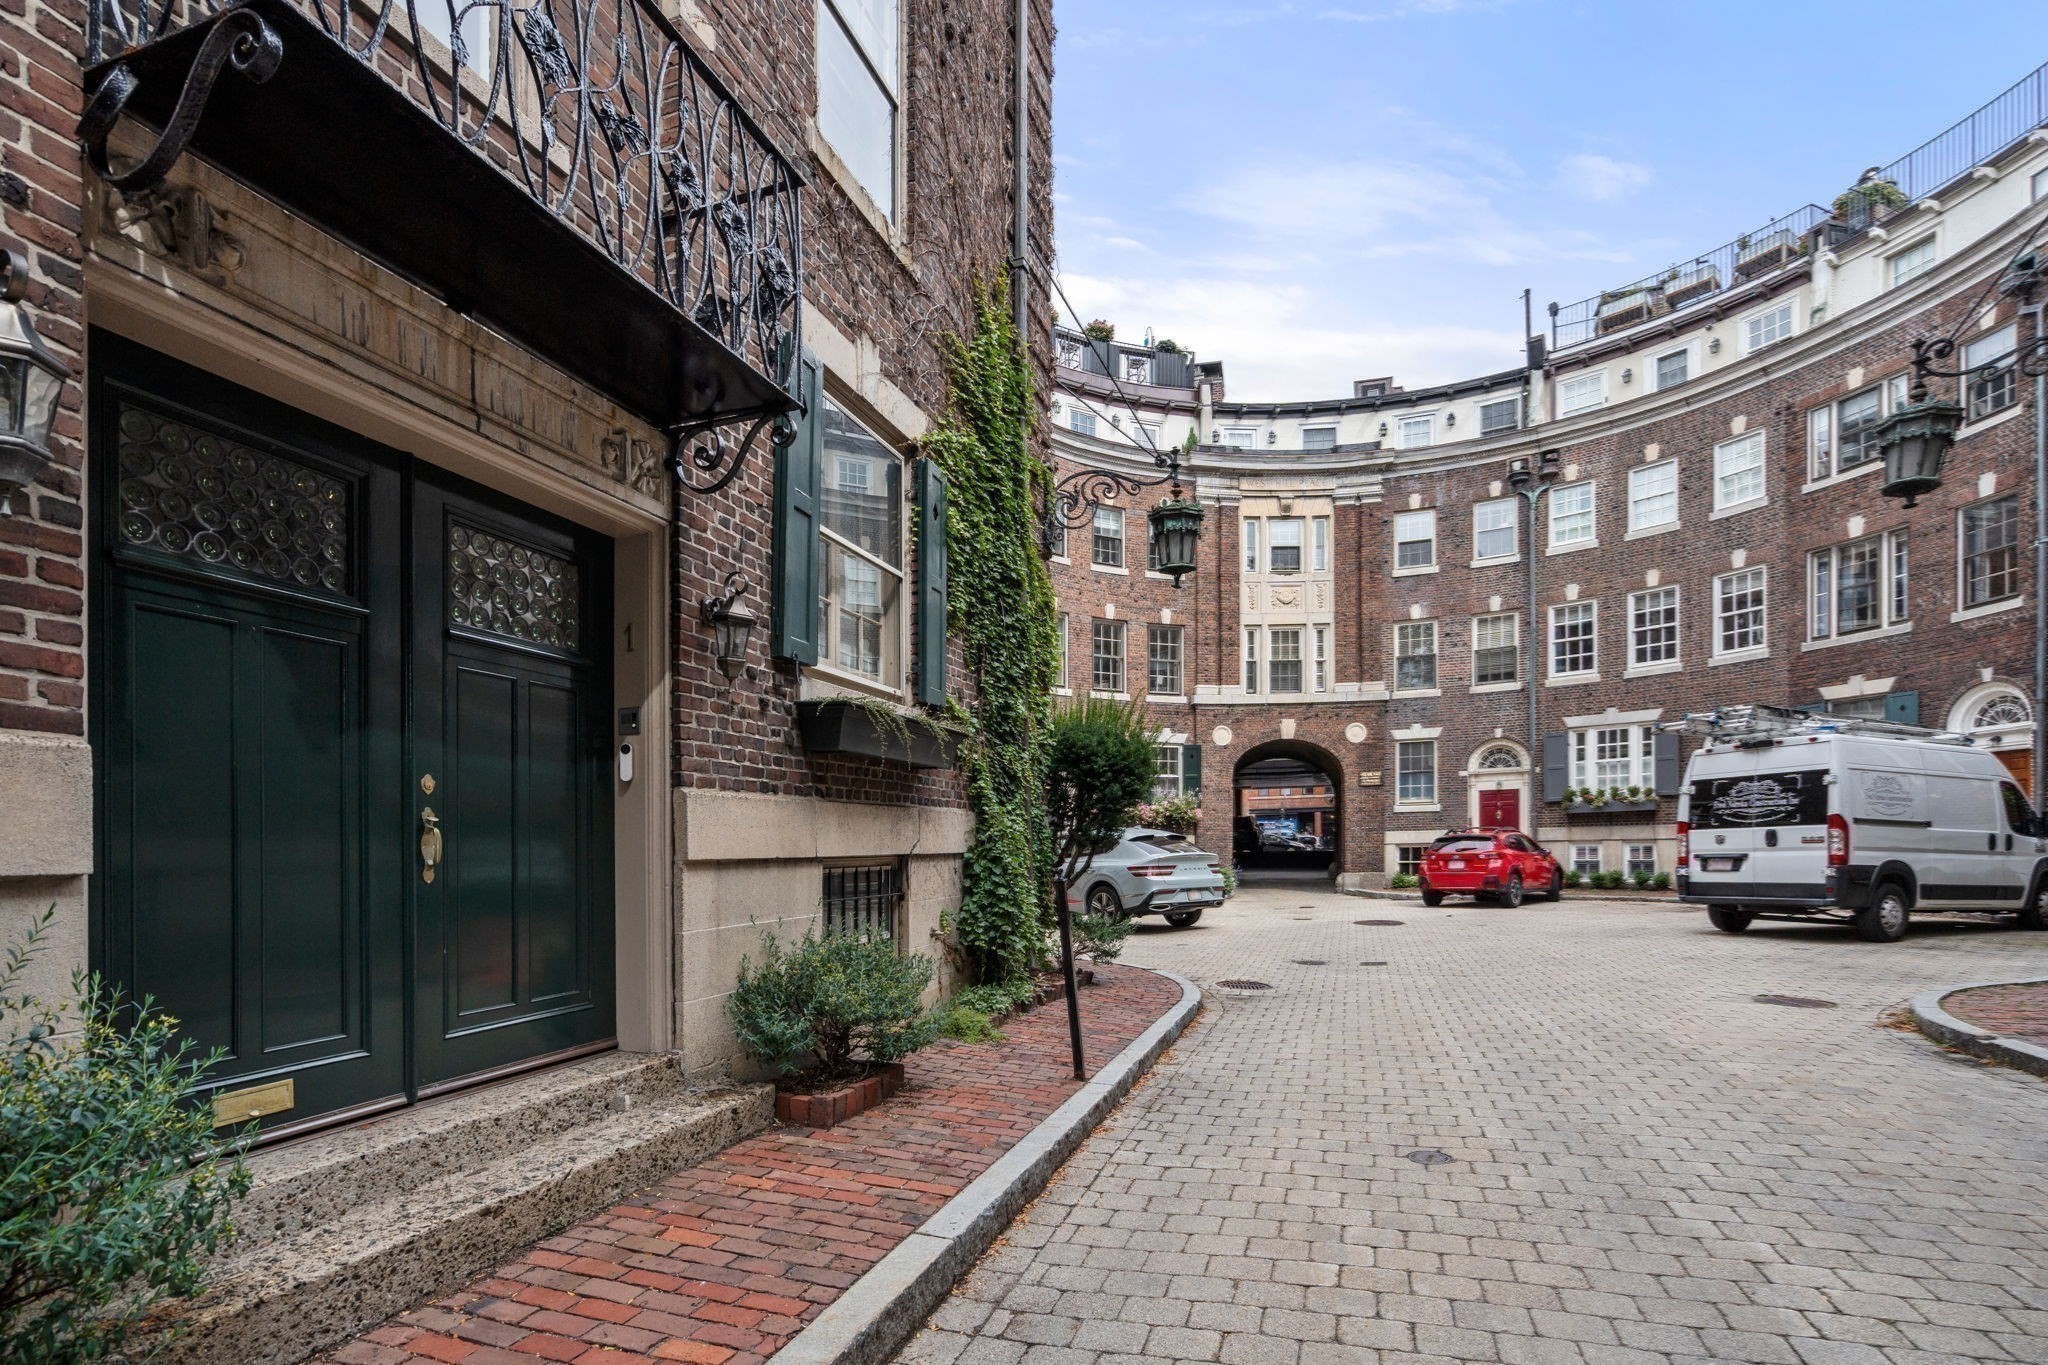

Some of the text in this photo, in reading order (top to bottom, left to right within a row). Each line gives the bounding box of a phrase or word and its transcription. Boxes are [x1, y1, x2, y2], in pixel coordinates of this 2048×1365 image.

[1275, 479, 1296, 488] HILL
[1299, 478, 1327, 488] PLACE
[623, 623, 634, 652] 1
